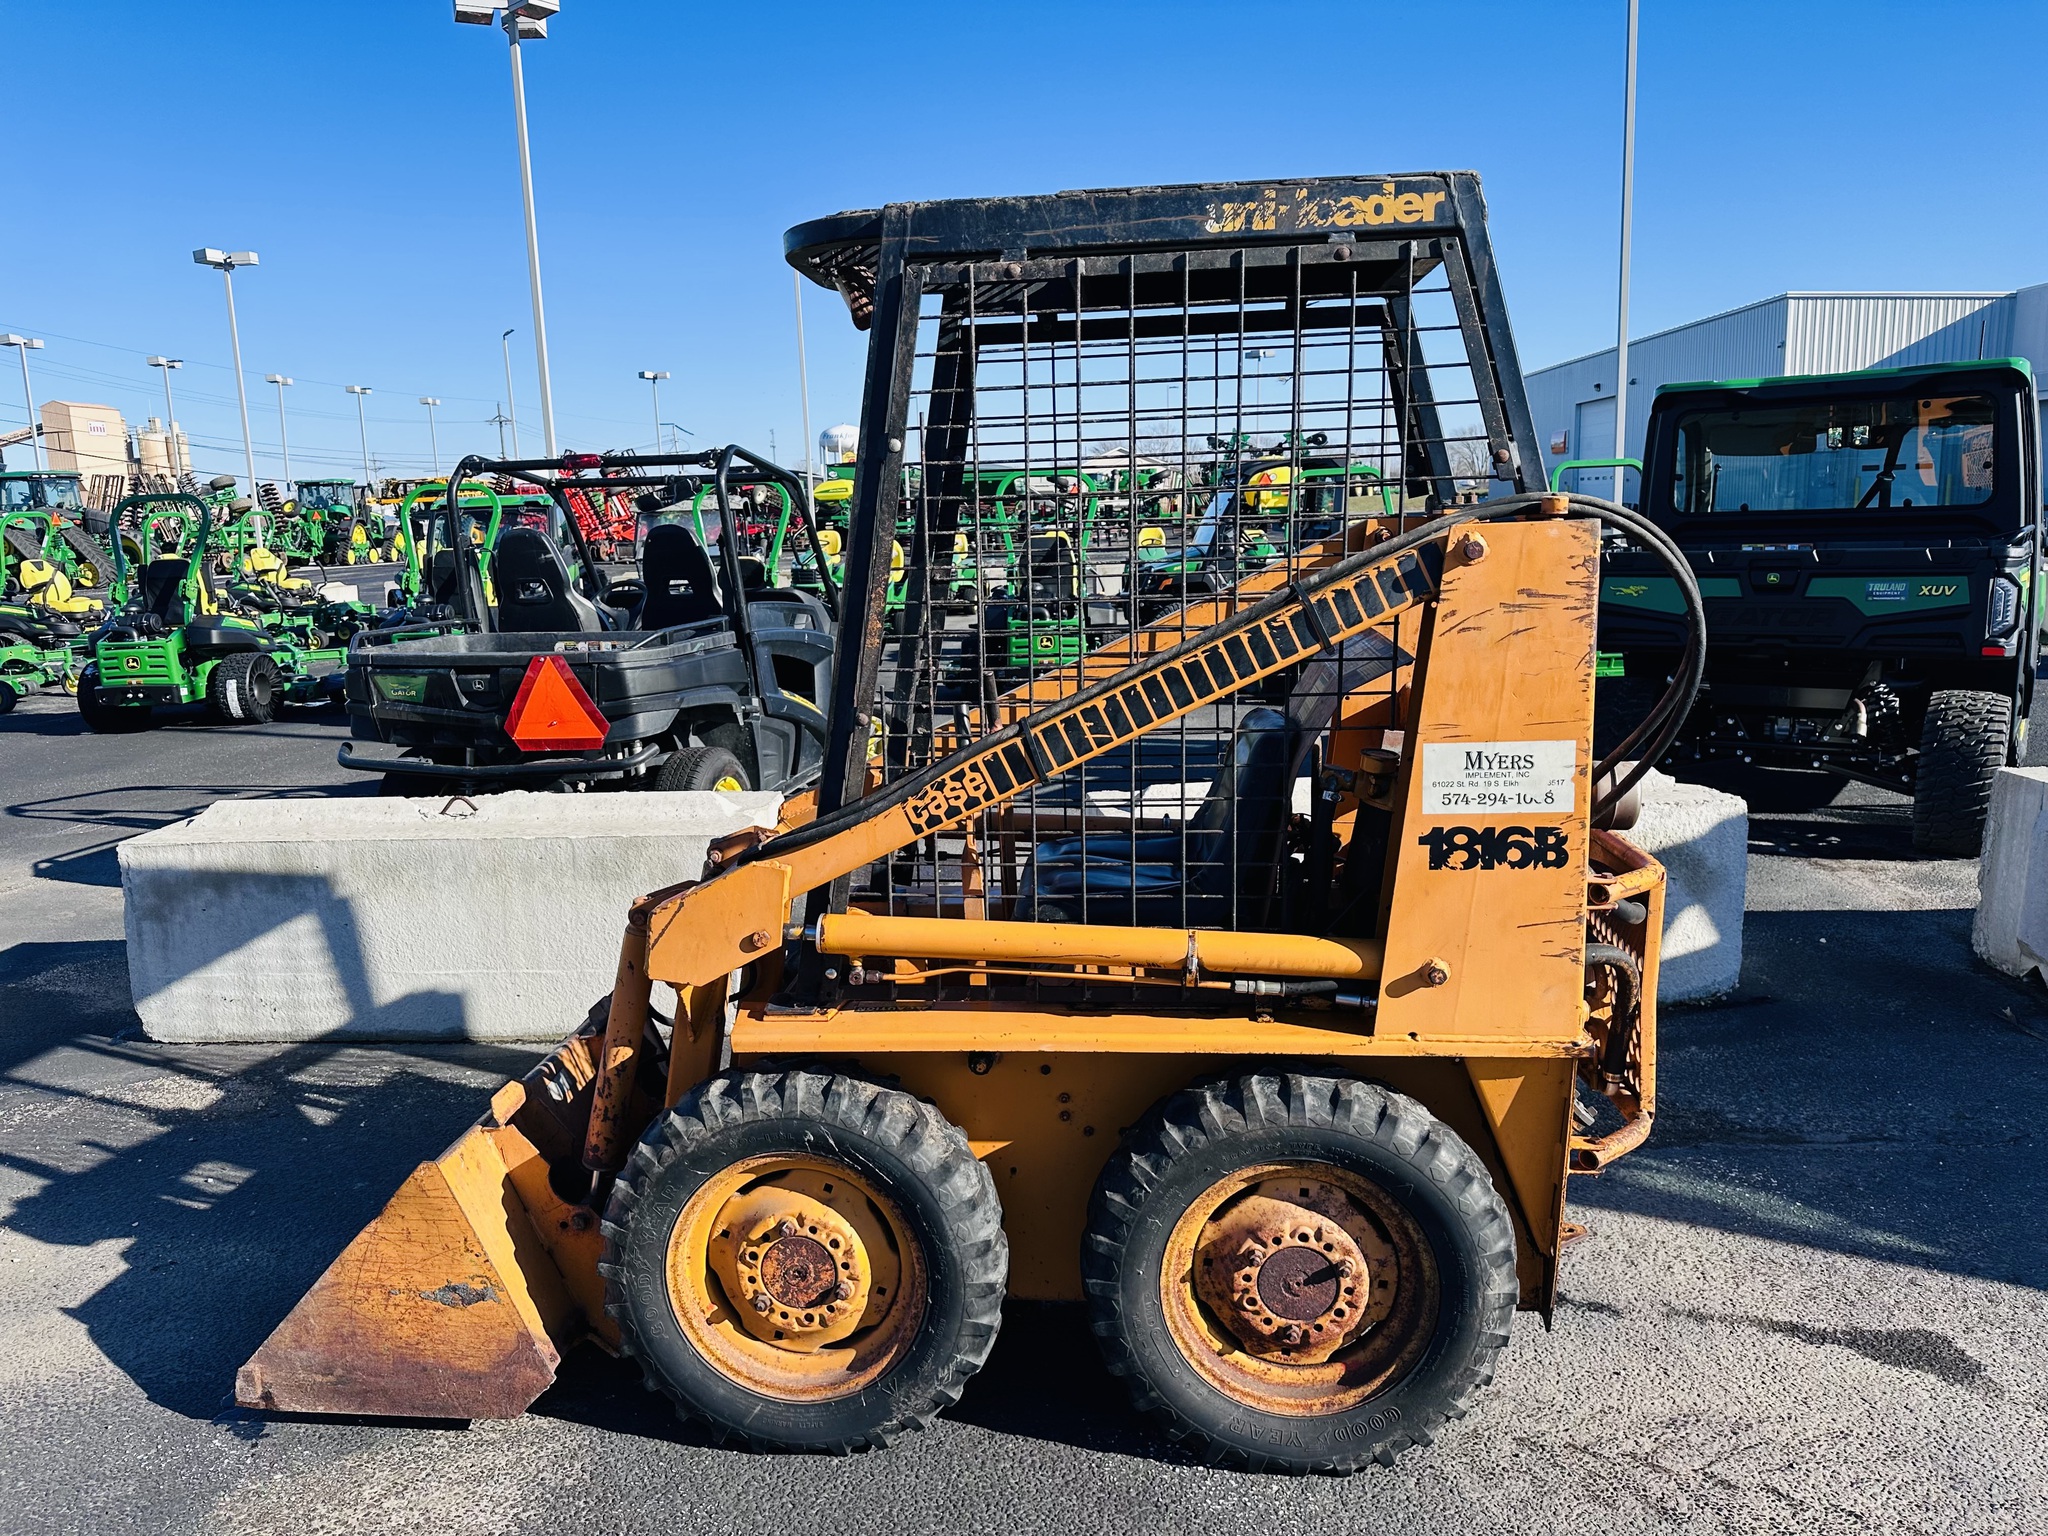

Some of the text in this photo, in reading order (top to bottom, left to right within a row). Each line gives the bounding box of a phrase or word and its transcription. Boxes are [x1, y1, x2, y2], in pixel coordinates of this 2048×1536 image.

[1868, 582, 1907, 592] TRULAND
[1918, 585, 1957, 596] XUV
[1465, 771, 1514, 779] IMPLEMENT,
[1441, 790, 1555, 807] 574-294-108
[1418, 825, 1569, 870] 1816B
